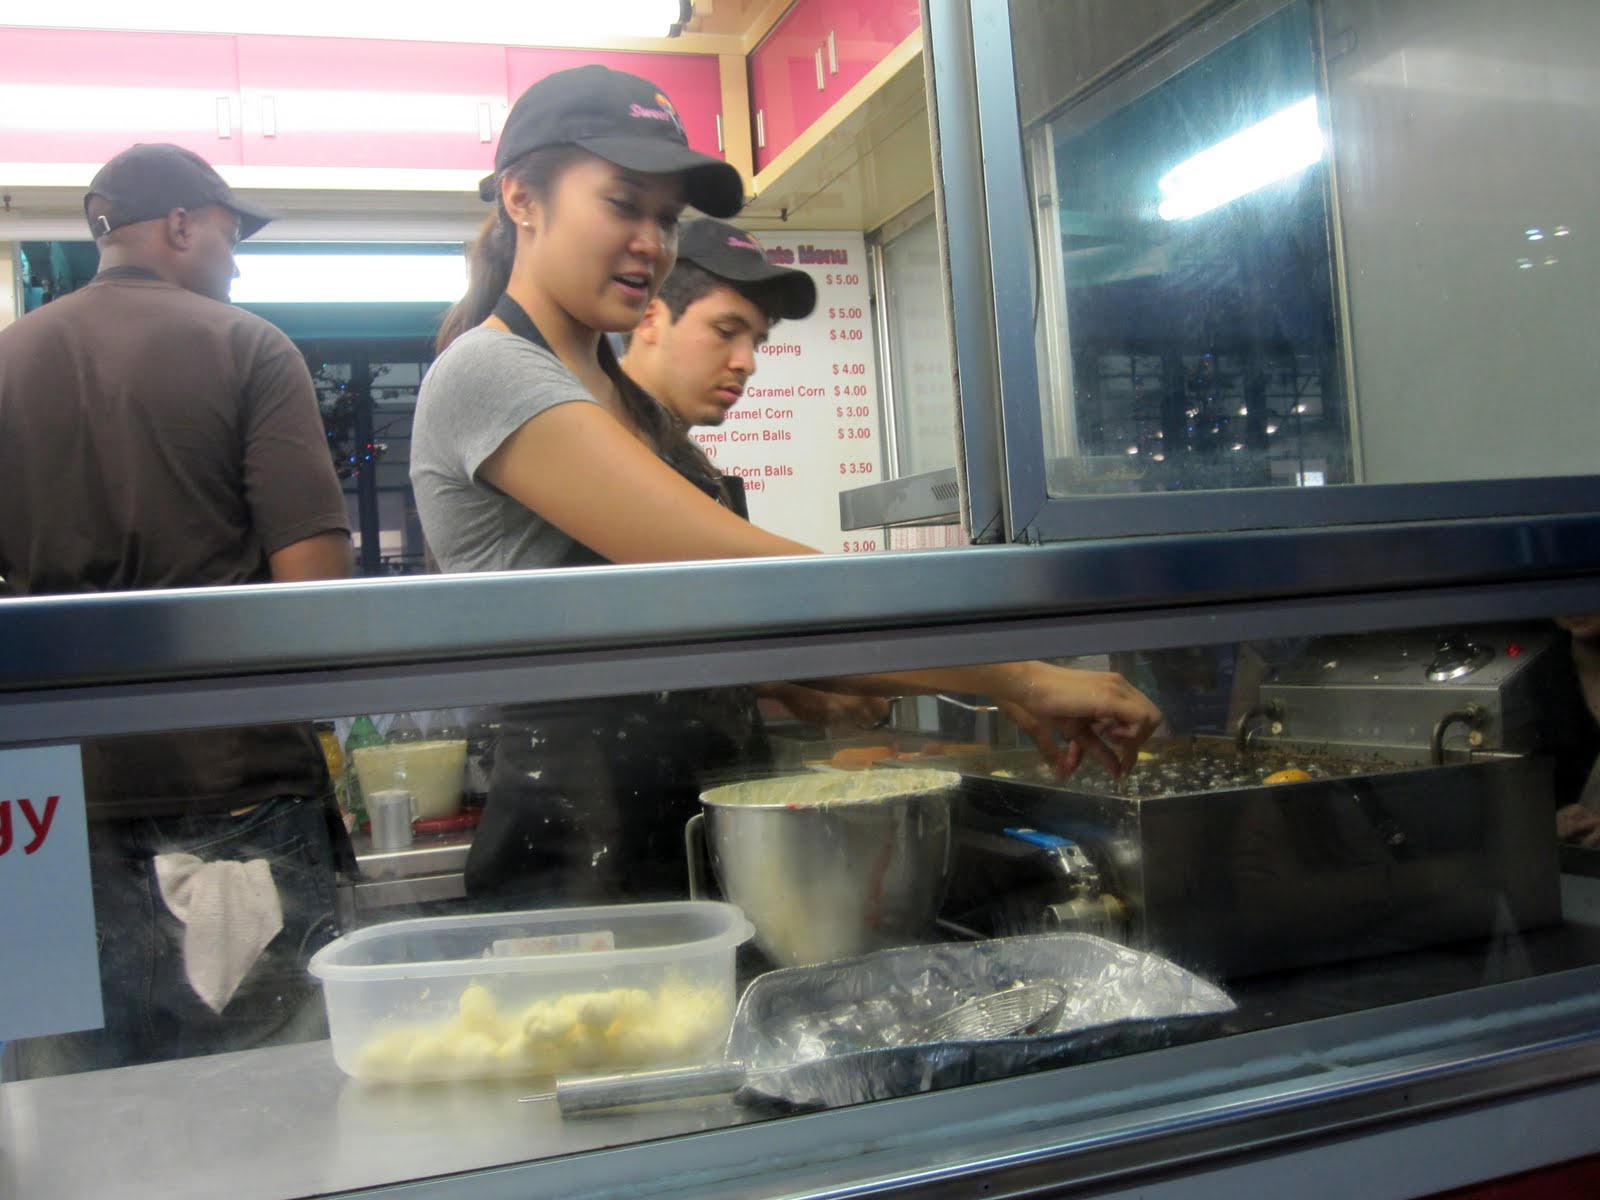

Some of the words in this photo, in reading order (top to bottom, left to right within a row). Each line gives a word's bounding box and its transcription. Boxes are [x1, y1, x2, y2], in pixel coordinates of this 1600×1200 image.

[797, 245, 848, 265] Menu
[836, 274, 859, 285] 5.00
[839, 307, 862, 318] 5.00
[840, 329, 863, 340] 4.00
[760, 342, 801, 356] opping
[842, 363, 865, 374] 4.00
[746, 386, 795, 398] Caramel
[797, 385, 825, 397] Corn
[843, 384, 867, 396] 4.00
[724, 408, 762, 420] aramel
[765, 407, 793, 419] Corn
[846, 405, 869, 417] 3.00
[730, 430, 759, 442] Corn
[762, 429, 791, 441] Balls
[848, 427, 871, 439] 3.00
[732, 466, 761, 478] Corn
[764, 464, 793, 477] Balls
[850, 462, 872, 474] 3.50
[853, 540, 876, 552] 3.00
